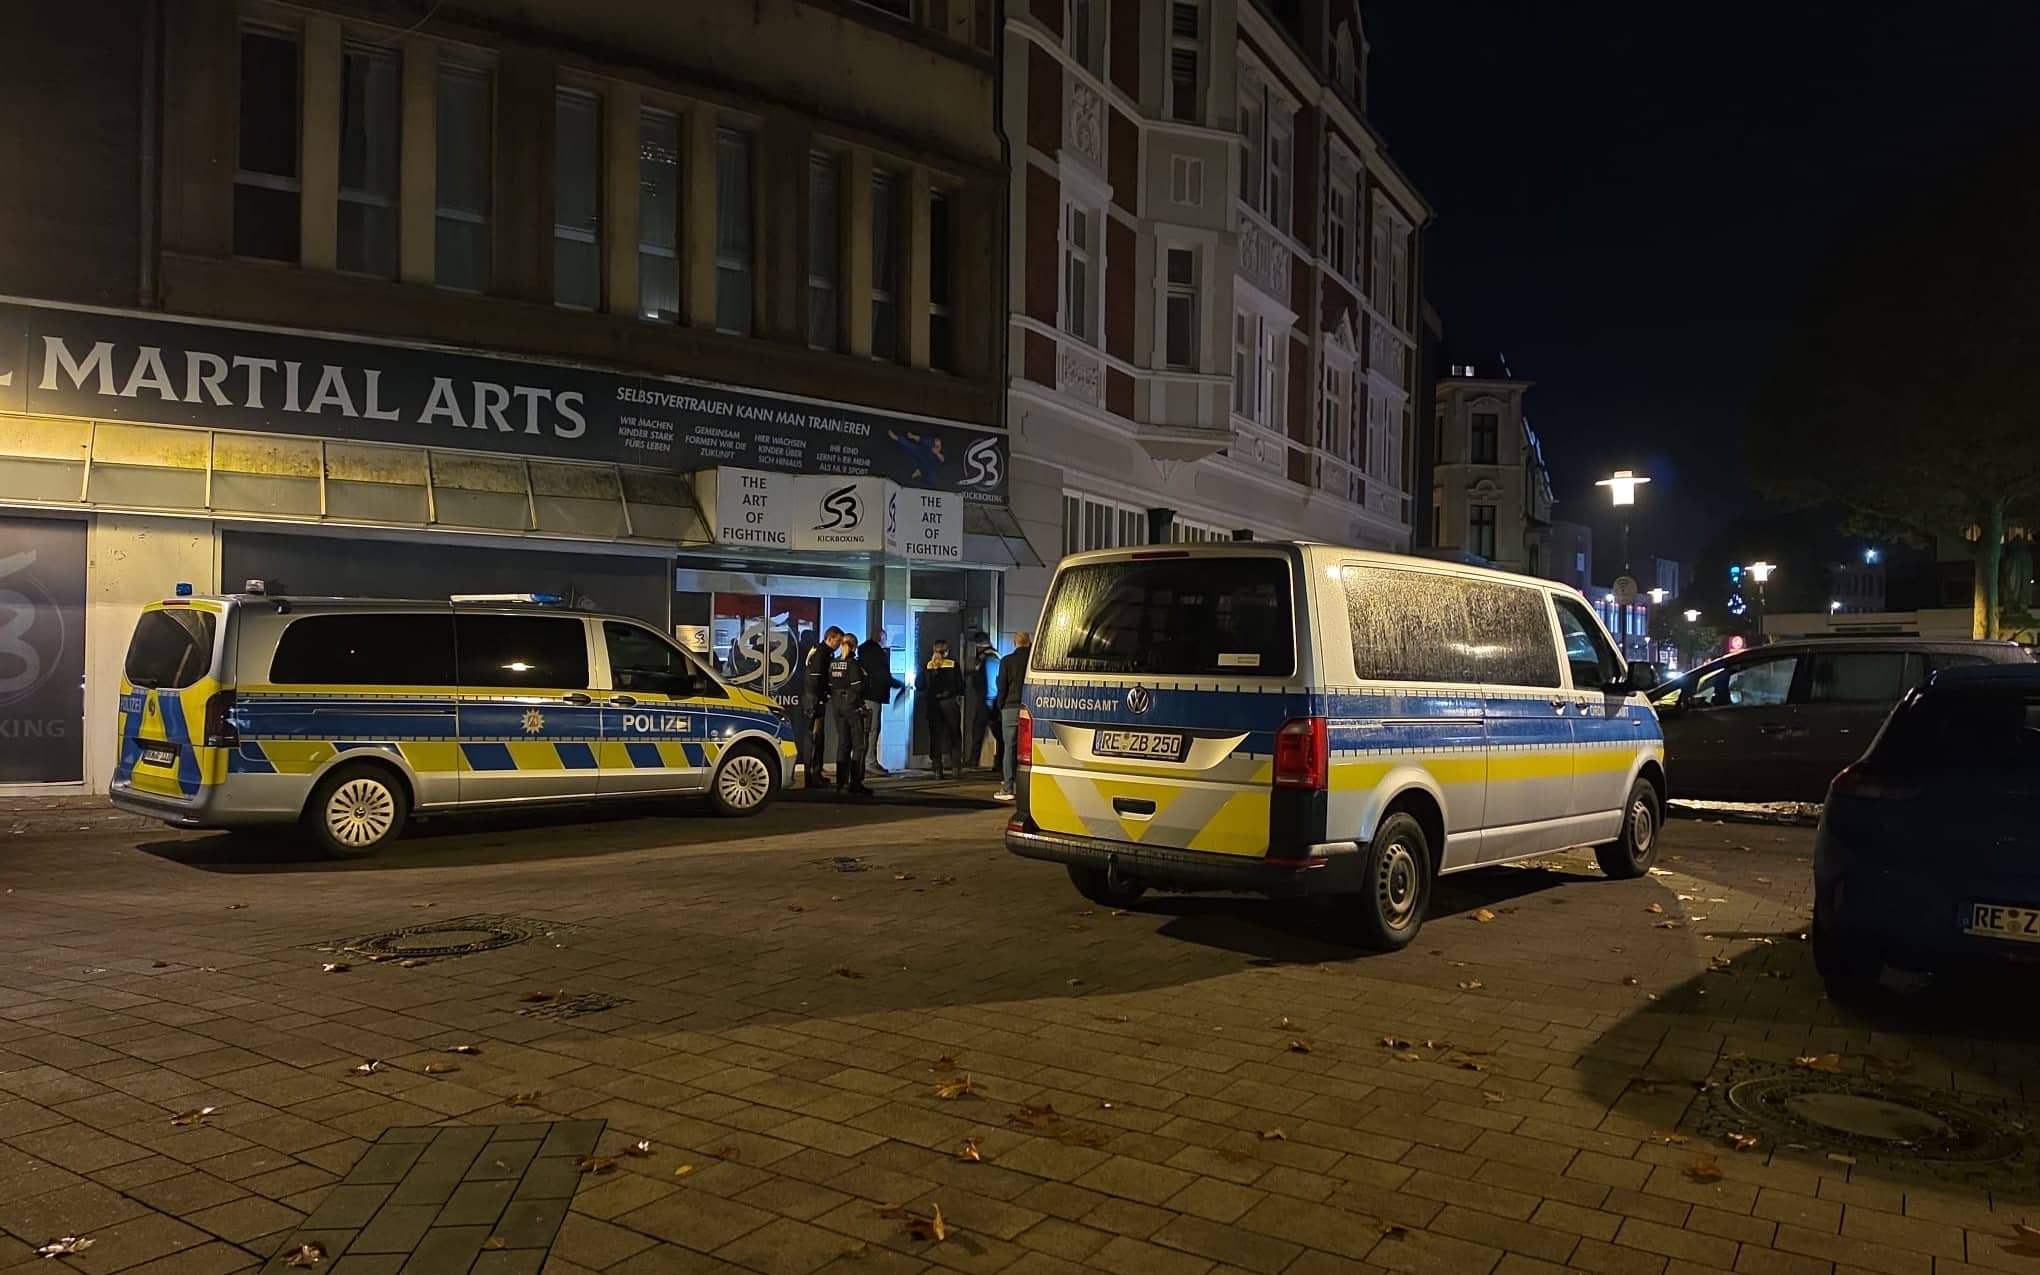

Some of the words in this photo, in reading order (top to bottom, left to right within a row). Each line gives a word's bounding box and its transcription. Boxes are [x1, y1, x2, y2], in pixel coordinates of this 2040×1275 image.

[38, 336, 400, 422] MARTIAL
[417, 377, 587, 439] ARTS
[616, 387, 733, 416] SELBSTVERTRAUEN
[736, 404, 773, 422] KANN
[775, 411, 806, 428] MAN
[620, 416, 637, 427] WIR
[638, 418, 674, 431] MACHEN
[618, 427, 648, 438] KINDER
[650, 431, 674, 441] STARK
[694, 426, 740, 439] GEMEINSAM
[624, 437, 645, 448] FÜRS
[646, 442, 671, 452] LEBEN
[685, 435, 717, 447] FORMEN
[735, 442, 747, 450] DIE
[754, 434, 770, 443] HIER
[772, 436, 807, 448] WACHSEN
[700, 448, 735, 459] ZUKUNFT
[758, 445, 784, 455] KINDER
[741, 476, 767, 489] THE
[742, 494, 768, 507] ART
[920, 496, 942, 508] THE
[745, 511, 764, 524] OF
[922, 512, 942, 523] ART
[722, 527, 786, 543] FIGHTING
[817, 535, 865, 543] KICKBOXING
[925, 528, 940, 539] OF
[906, 543, 958, 556] FIGHTING
[1036, 696, 1119, 712] ORDNUNGSAMT
[622, 714, 691, 732] POLIZEI
[1102, 732, 1121, 749] RE
[1129, 735, 1148, 752] ZB
[1151, 736, 1180, 754] 250
[1975, 906, 2005, 929] RE
